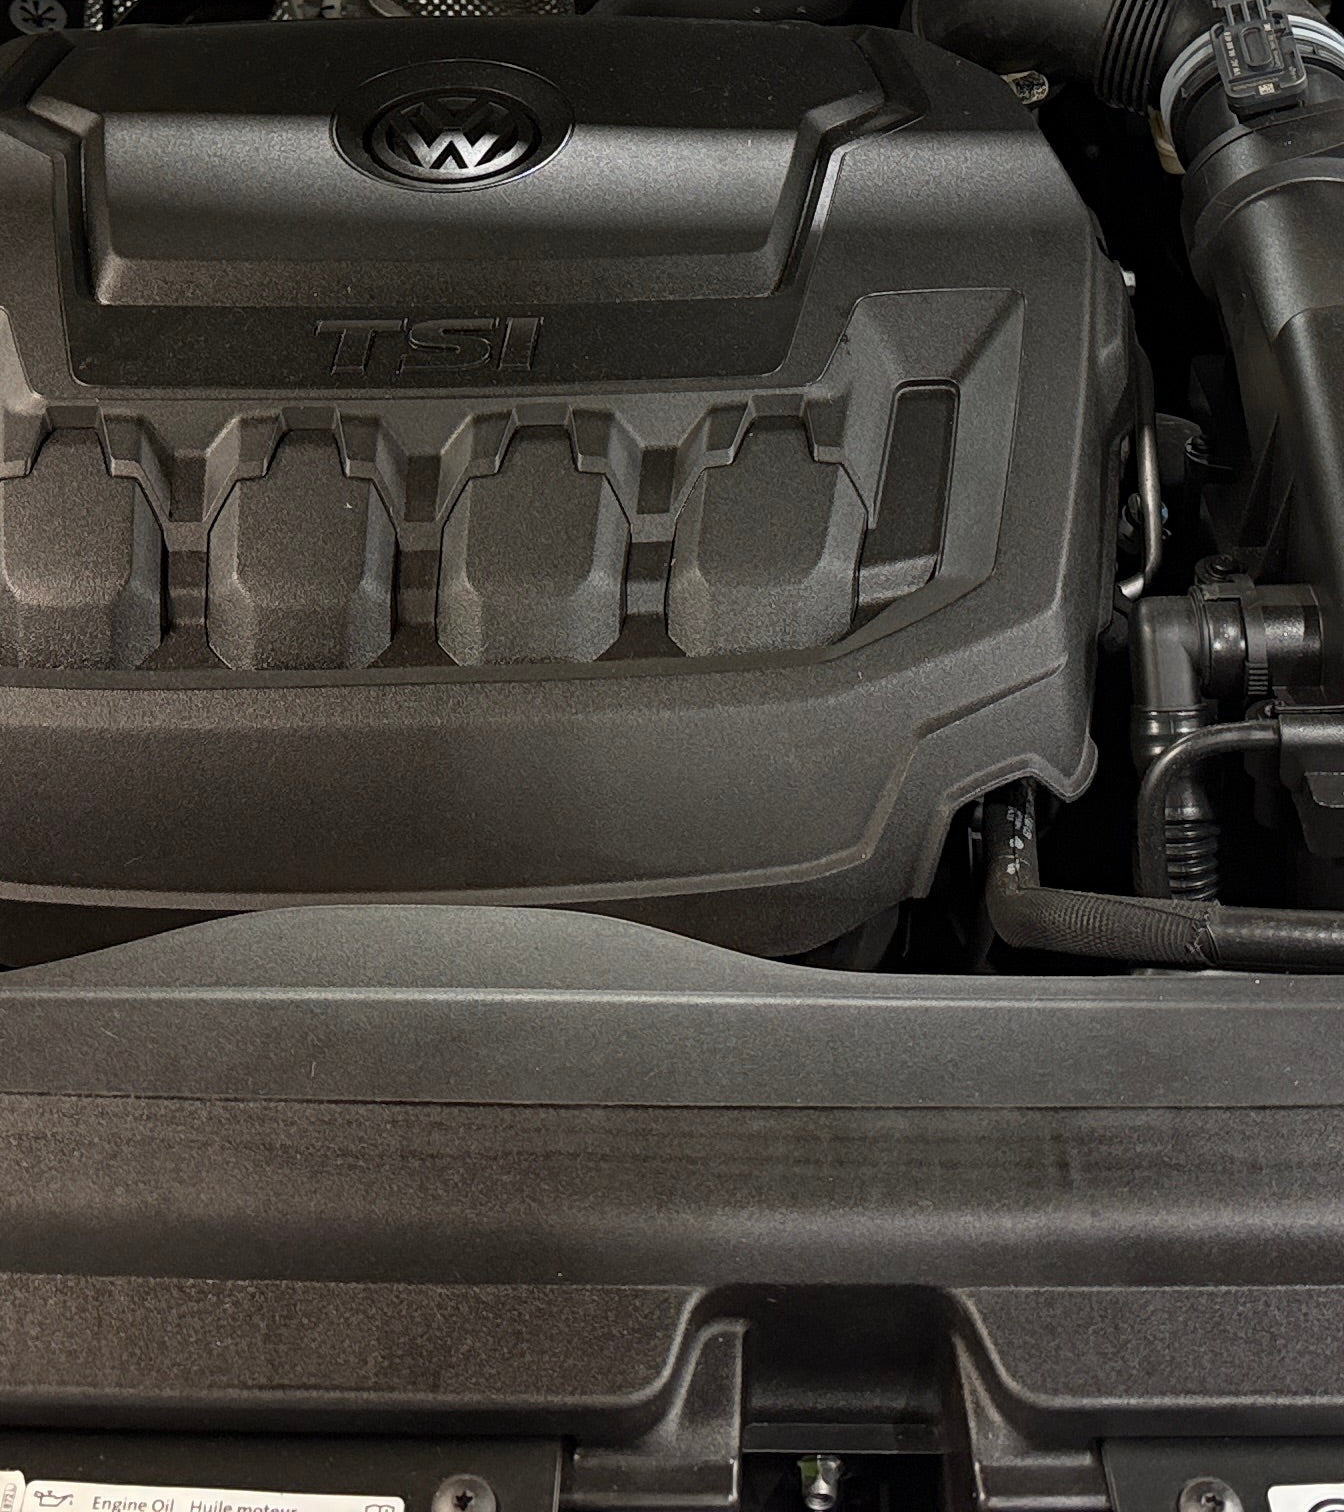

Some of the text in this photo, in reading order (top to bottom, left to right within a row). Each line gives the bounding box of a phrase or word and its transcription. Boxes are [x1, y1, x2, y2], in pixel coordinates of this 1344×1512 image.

[313, 316, 544, 376] TSI
[92, 1496, 148, 1512] Engine
[151, 1499, 175, 1512] Oil
[190, 1500, 233, 1512] Huile
